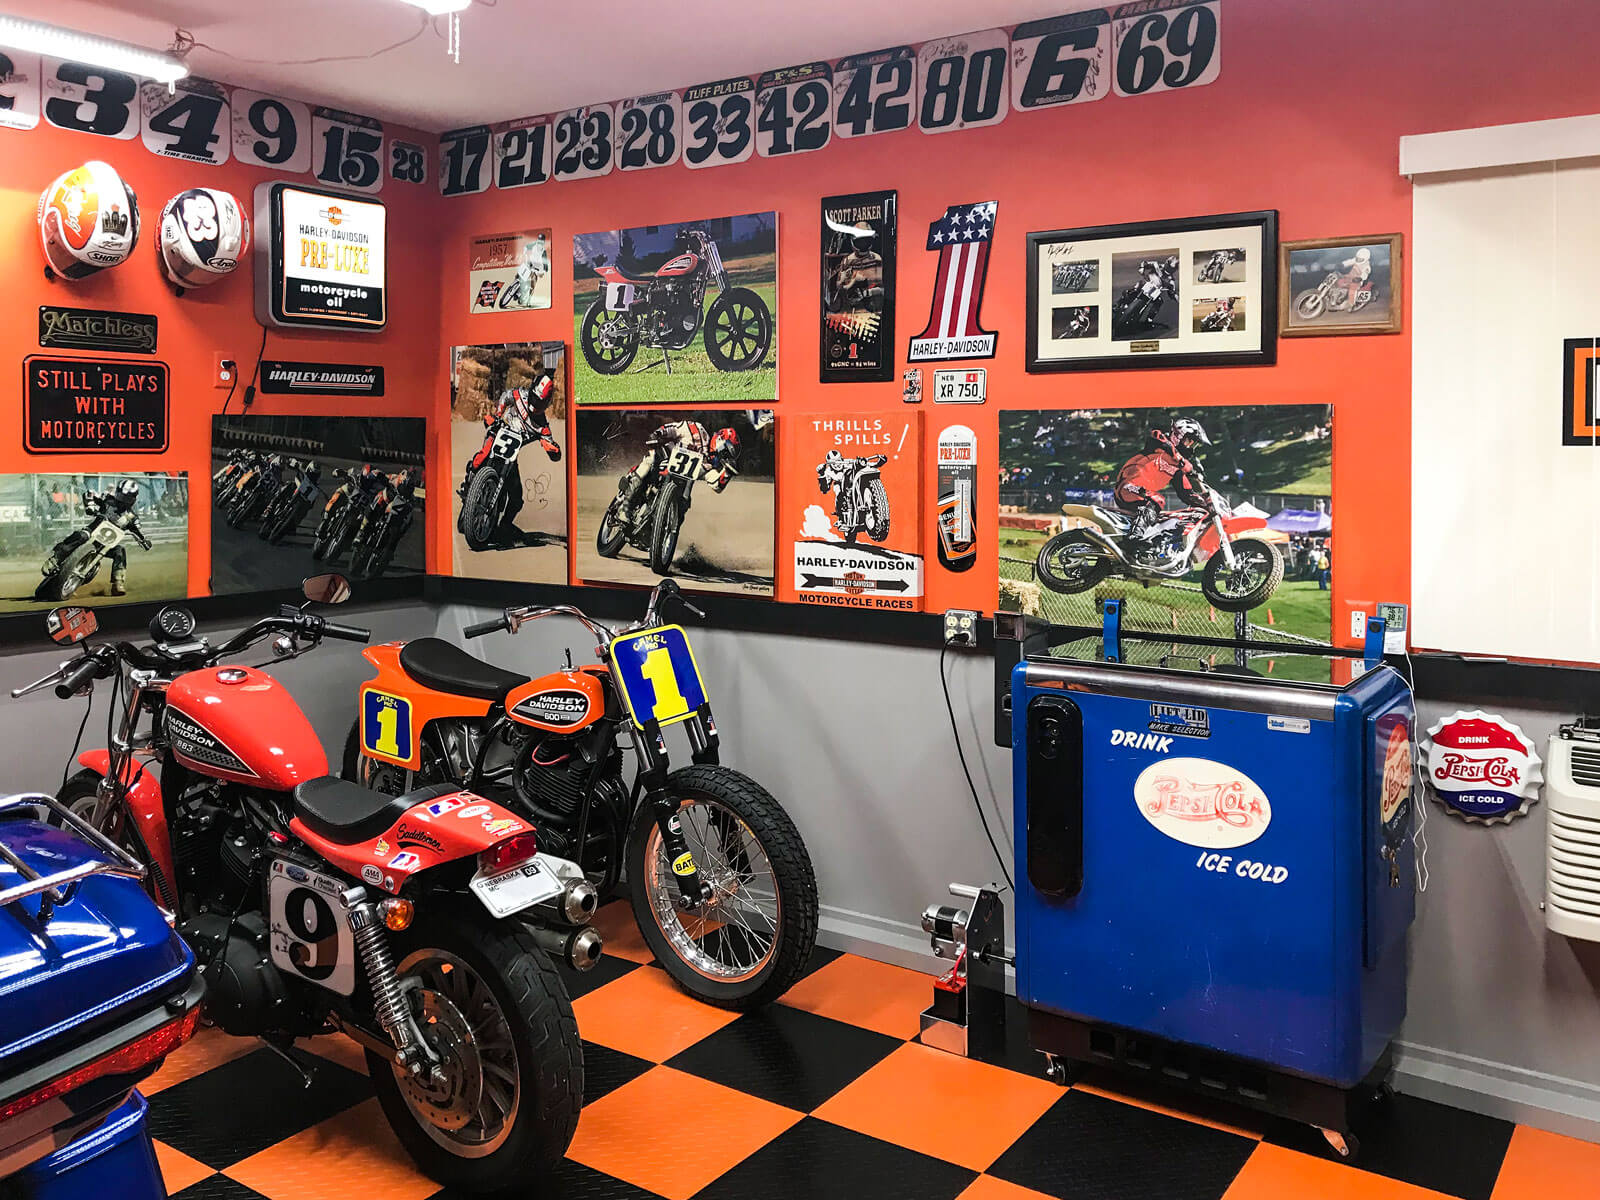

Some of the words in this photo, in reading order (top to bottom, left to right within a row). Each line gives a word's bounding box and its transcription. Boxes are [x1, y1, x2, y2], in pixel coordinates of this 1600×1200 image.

[1117, 6, 1217, 94] 69
[1020, 27, 1098, 107] 6
[46, 63, 137, 135] 3
[688, 86, 713, 99] TUFF
[713, 80, 750, 96] PLATES
[836, 60, 912, 135] 42
[920, 48, 1007, 129] 80
[150, 94, 223, 158] 4
[686, 94, 751, 164] 33
[758, 82, 830, 155] 42
[248, 99, 297, 164] 9
[554, 111, 611, 175] 23
[621, 104, 675, 169] 28
[181, 154, 218, 164] CHAMPION
[317, 126, 382, 187] 15
[392, 148, 424, 183] 28
[442, 134, 489, 195] 17
[499, 124, 547, 188] 21
[852, 205, 881, 222] PARKER
[300, 238, 369, 274] PRE-LUXE
[300, 283, 368, 299] motorcycle
[326, 297, 343, 308] oil
[42, 311, 156, 349] Matchless
[913, 340, 990, 355] HARLEY-DAVIDSON
[37, 370, 91, 390] STILL
[102, 373, 158, 392] PLAYS
[269, 370, 376, 385] HARLEY-DAVIDSON
[941, 384, 954, 398] XR
[959, 383, 979, 397] 750
[75, 396, 125, 415] WITH
[41, 420, 155, 440] MOTORCYCLES
[812, 419, 883, 432] THRILLS
[493, 433, 520, 458] 3
[834, 433, 892, 445] SPILLS
[669, 452, 700, 478] 31
[797, 556, 915, 571] HARLEY-DAVIDSON
[799, 594, 872, 607] MOTORCYCLE
[875, 600, 913, 609] RACES
[633, 634, 667, 651] CAMEL
[641, 647, 690, 721] 1
[529, 700, 585, 711] DAVIDSON
[1185, 708, 1206, 722] LID
[376, 706, 398, 756] 1
[1110, 729, 1174, 754] DRINK
[1150, 722, 1169, 732] MAKE
[1172, 726, 1211, 738] SELECTION
[1458, 736, 1490, 744] DRINK
[177, 739, 193, 752] 883
[1459, 794, 1475, 803] ICE
[1477, 796, 1504, 804] COLD
[397, 823, 441, 848] Saddlemen
[484, 870, 520, 887] NEBRASKA
[1196, 851, 1232, 873] ICE
[1236, 860, 1289, 884] COLD
[488, 884, 500, 892] MC
[285, 887, 339, 980] 9
